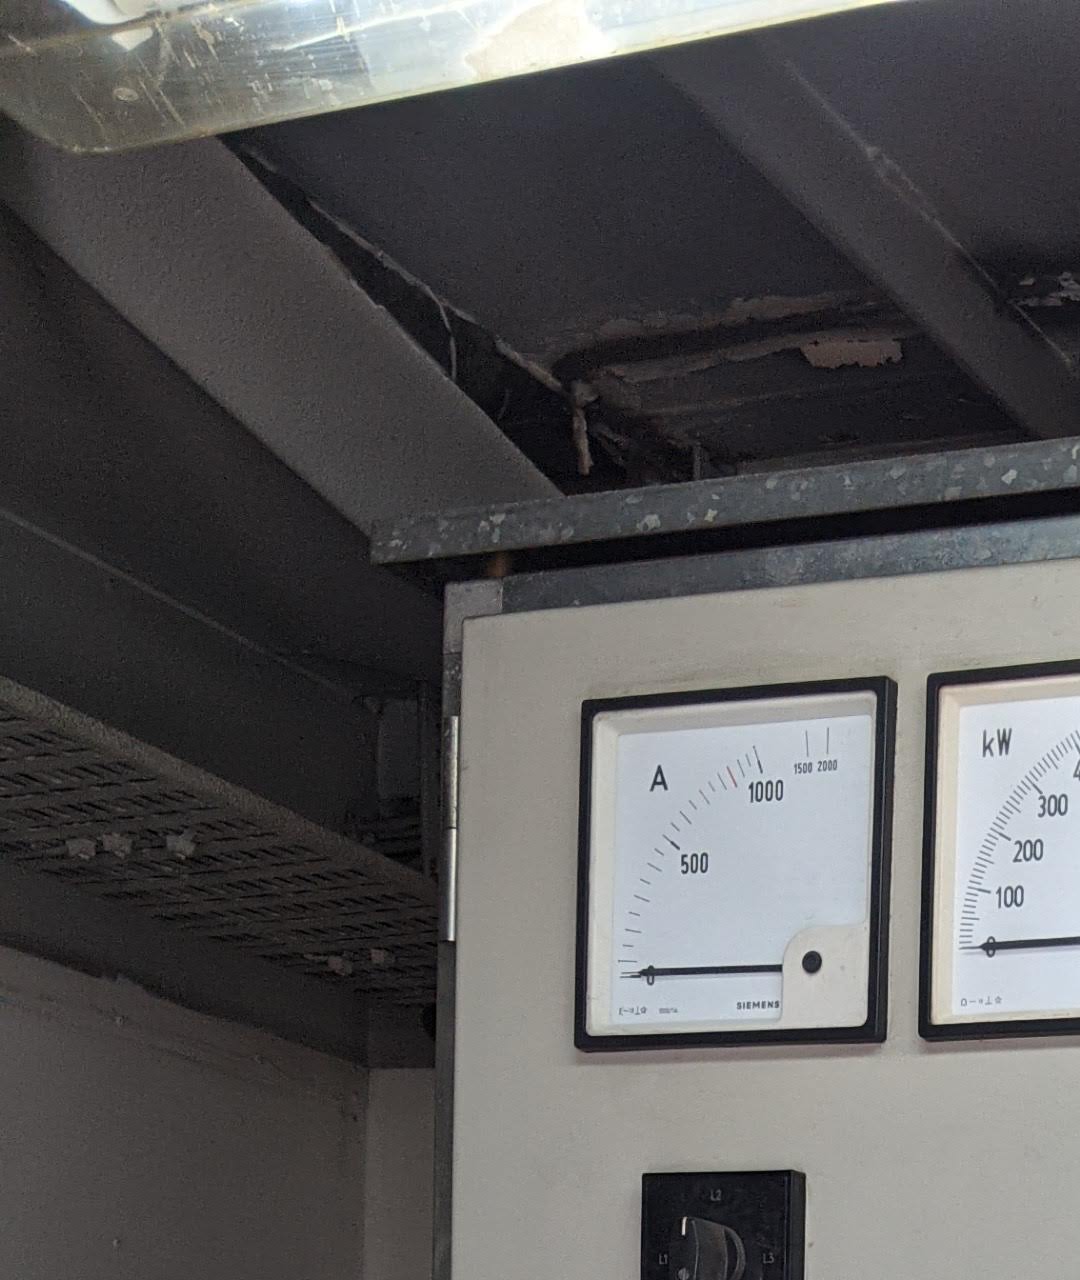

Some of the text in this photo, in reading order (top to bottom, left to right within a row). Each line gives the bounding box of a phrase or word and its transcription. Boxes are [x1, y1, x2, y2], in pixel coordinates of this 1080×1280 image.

[982, 728, 1013, 757] kW
[650, 765, 669, 792] A
[794, 759, 838, 775] 1500 2000
[748, 780, 784, 803] 1000
[1037, 794, 1068, 818] 300
[1012, 838, 1044, 862] 200
[680, 852, 709, 875] 500
[995, 885, 1025, 908] 100
[736, 1000, 780, 1010] SIEMENS
